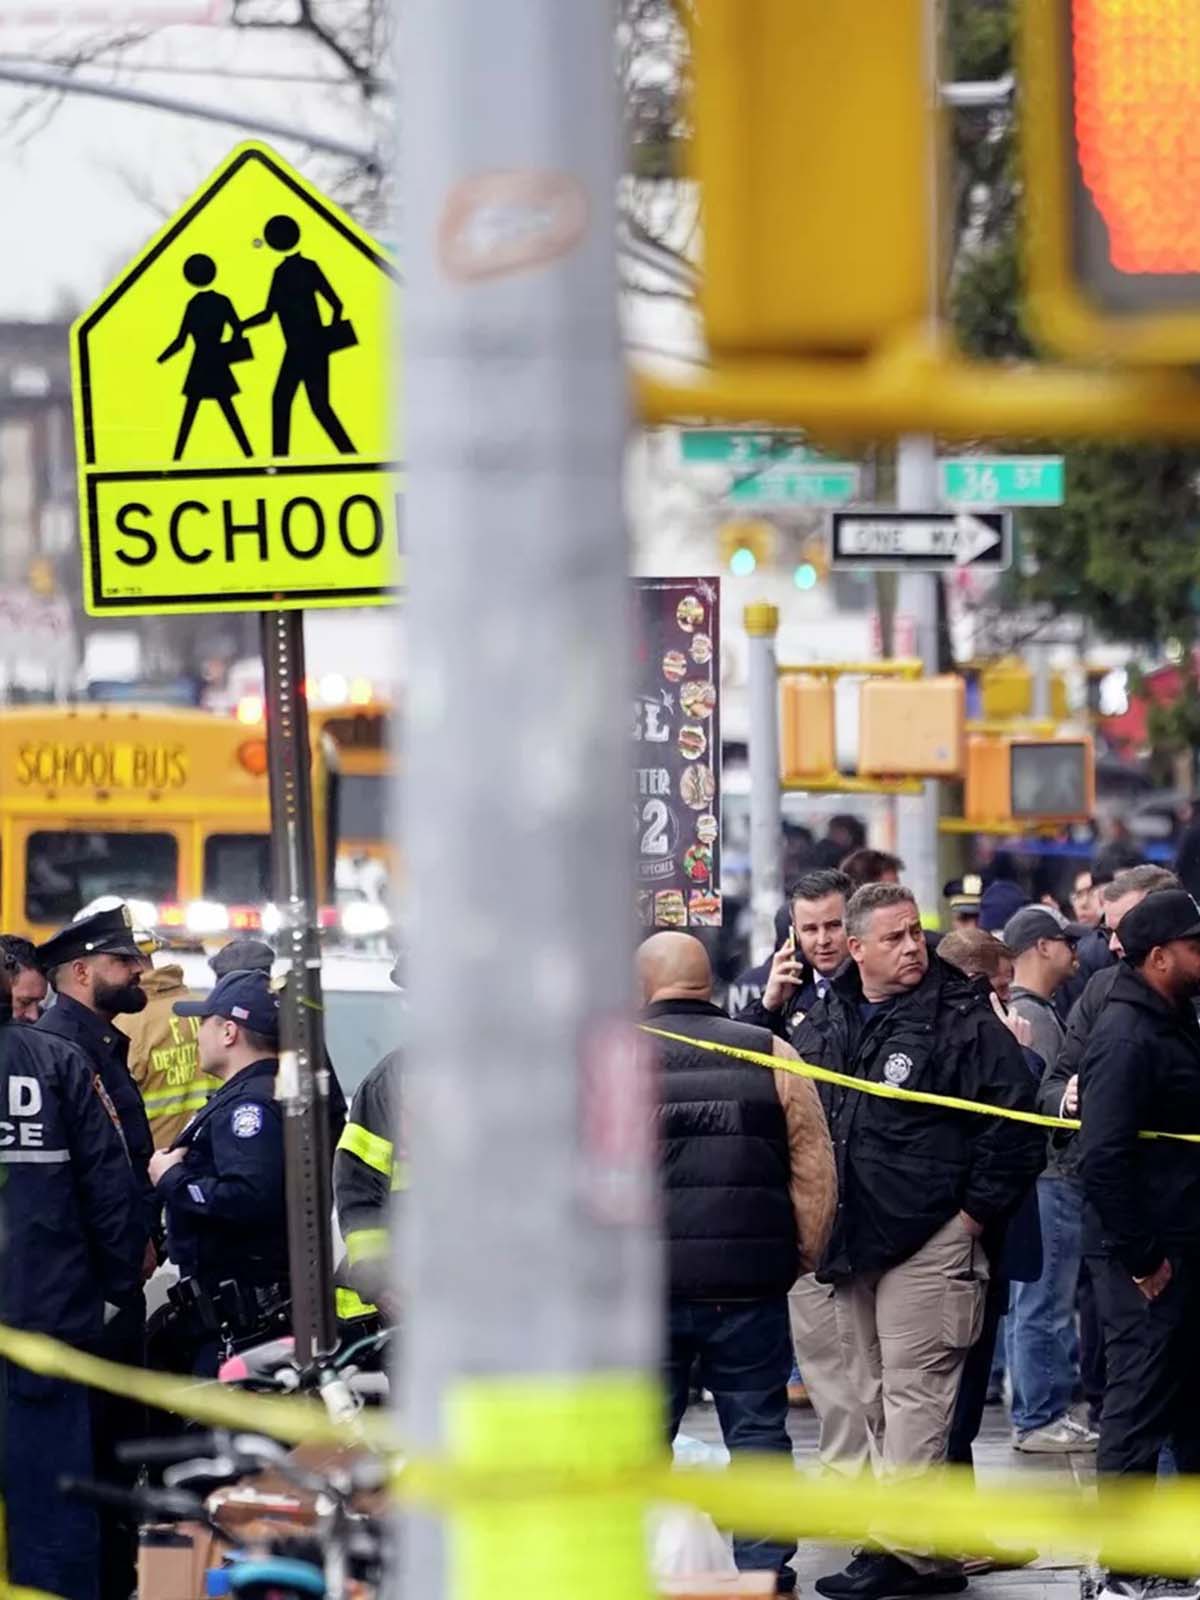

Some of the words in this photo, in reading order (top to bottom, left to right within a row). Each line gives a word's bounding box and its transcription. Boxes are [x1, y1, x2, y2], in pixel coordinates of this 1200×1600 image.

[961, 463, 999, 500] 36
[115, 493, 404, 568] SCHOO
[854, 521, 904, 554] ONE
[17, 741, 127, 788] SCHOOL
[132, 742, 188, 788] BUS
